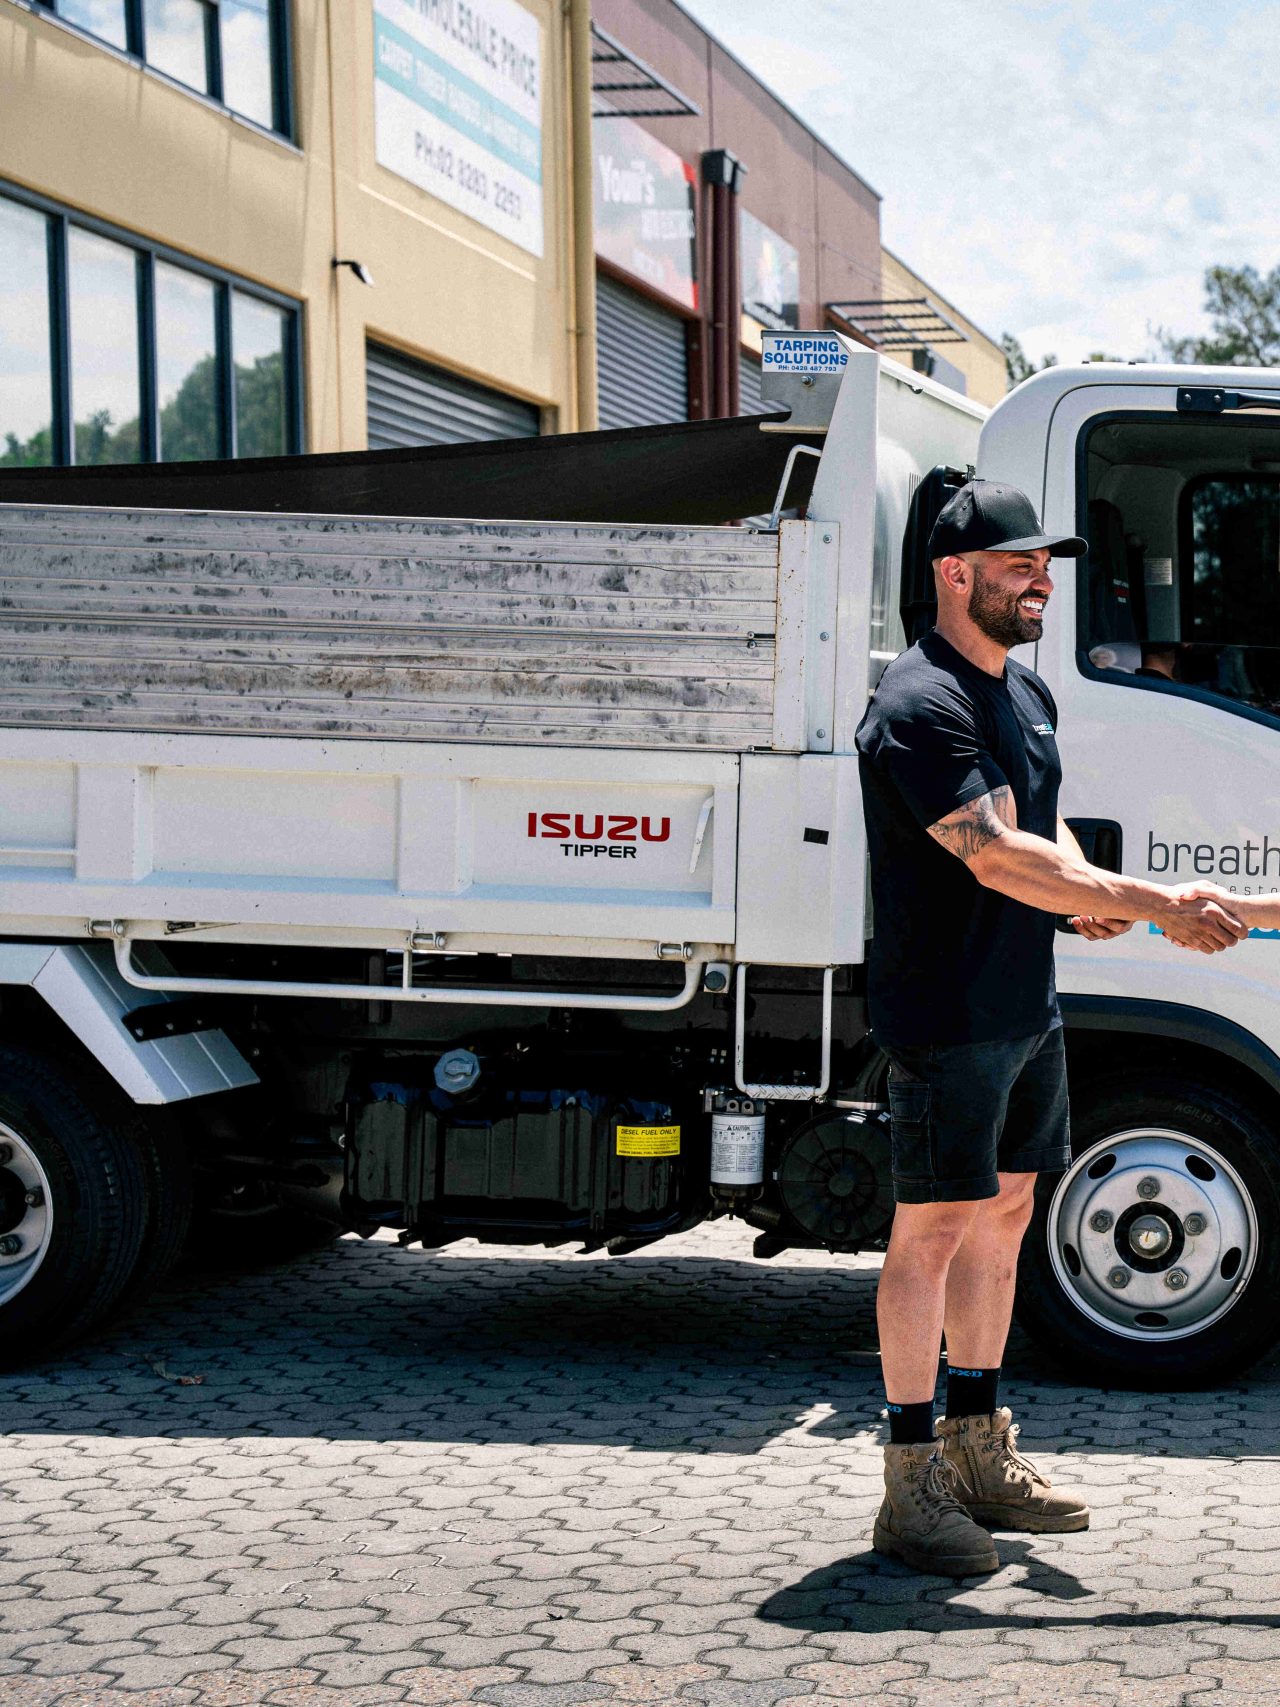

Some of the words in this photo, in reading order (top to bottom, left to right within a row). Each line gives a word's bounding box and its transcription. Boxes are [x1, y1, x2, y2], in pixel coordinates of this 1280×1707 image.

[501, 36, 536, 98] PRICE
[774, 340, 839, 352] TARPING
[764, 352, 849, 366] SOLUTIONS
[528, 812, 671, 842] ISUZU
[560, 843, 638, 860] TIPPER
